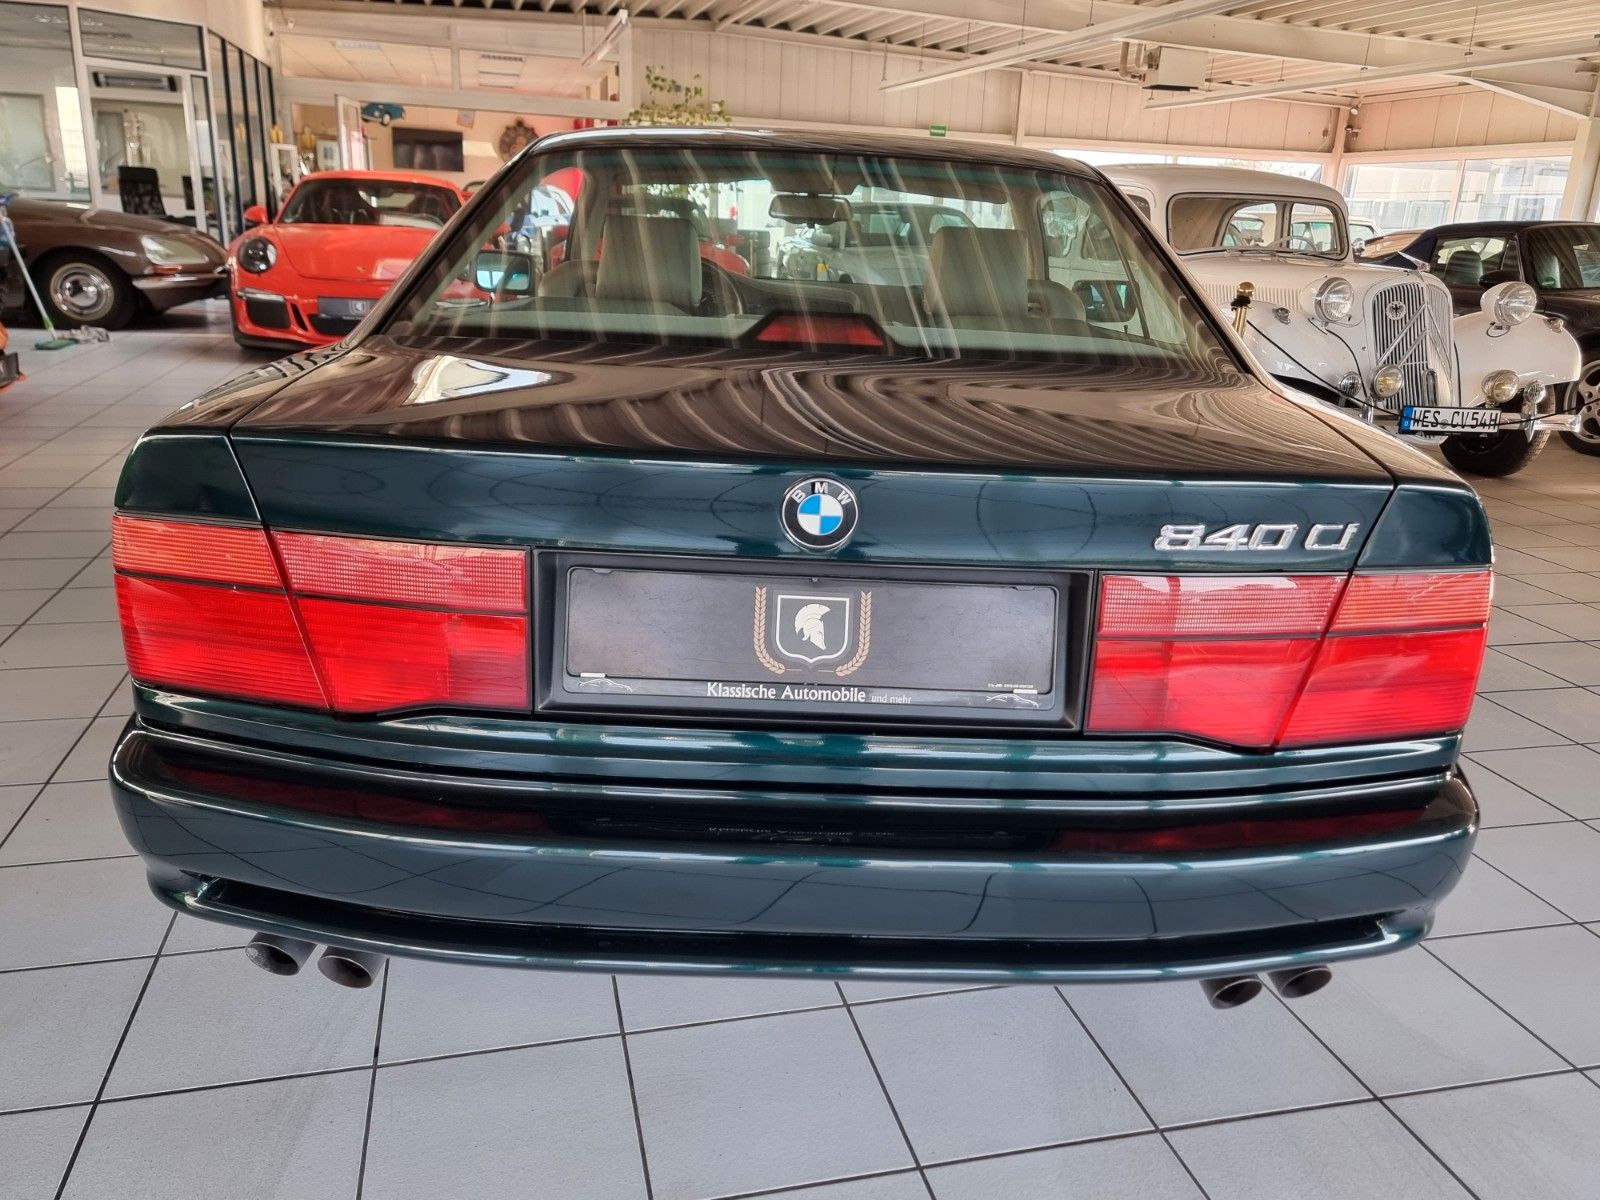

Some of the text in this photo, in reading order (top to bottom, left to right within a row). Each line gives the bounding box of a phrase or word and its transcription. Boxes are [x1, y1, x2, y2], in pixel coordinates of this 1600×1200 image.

[1413, 410, 1441, 428] WES
[791, 481, 852, 505] BMW
[1154, 523, 1299, 551] 840
[706, 682, 912, 704] Klassische Automobile und mehr
